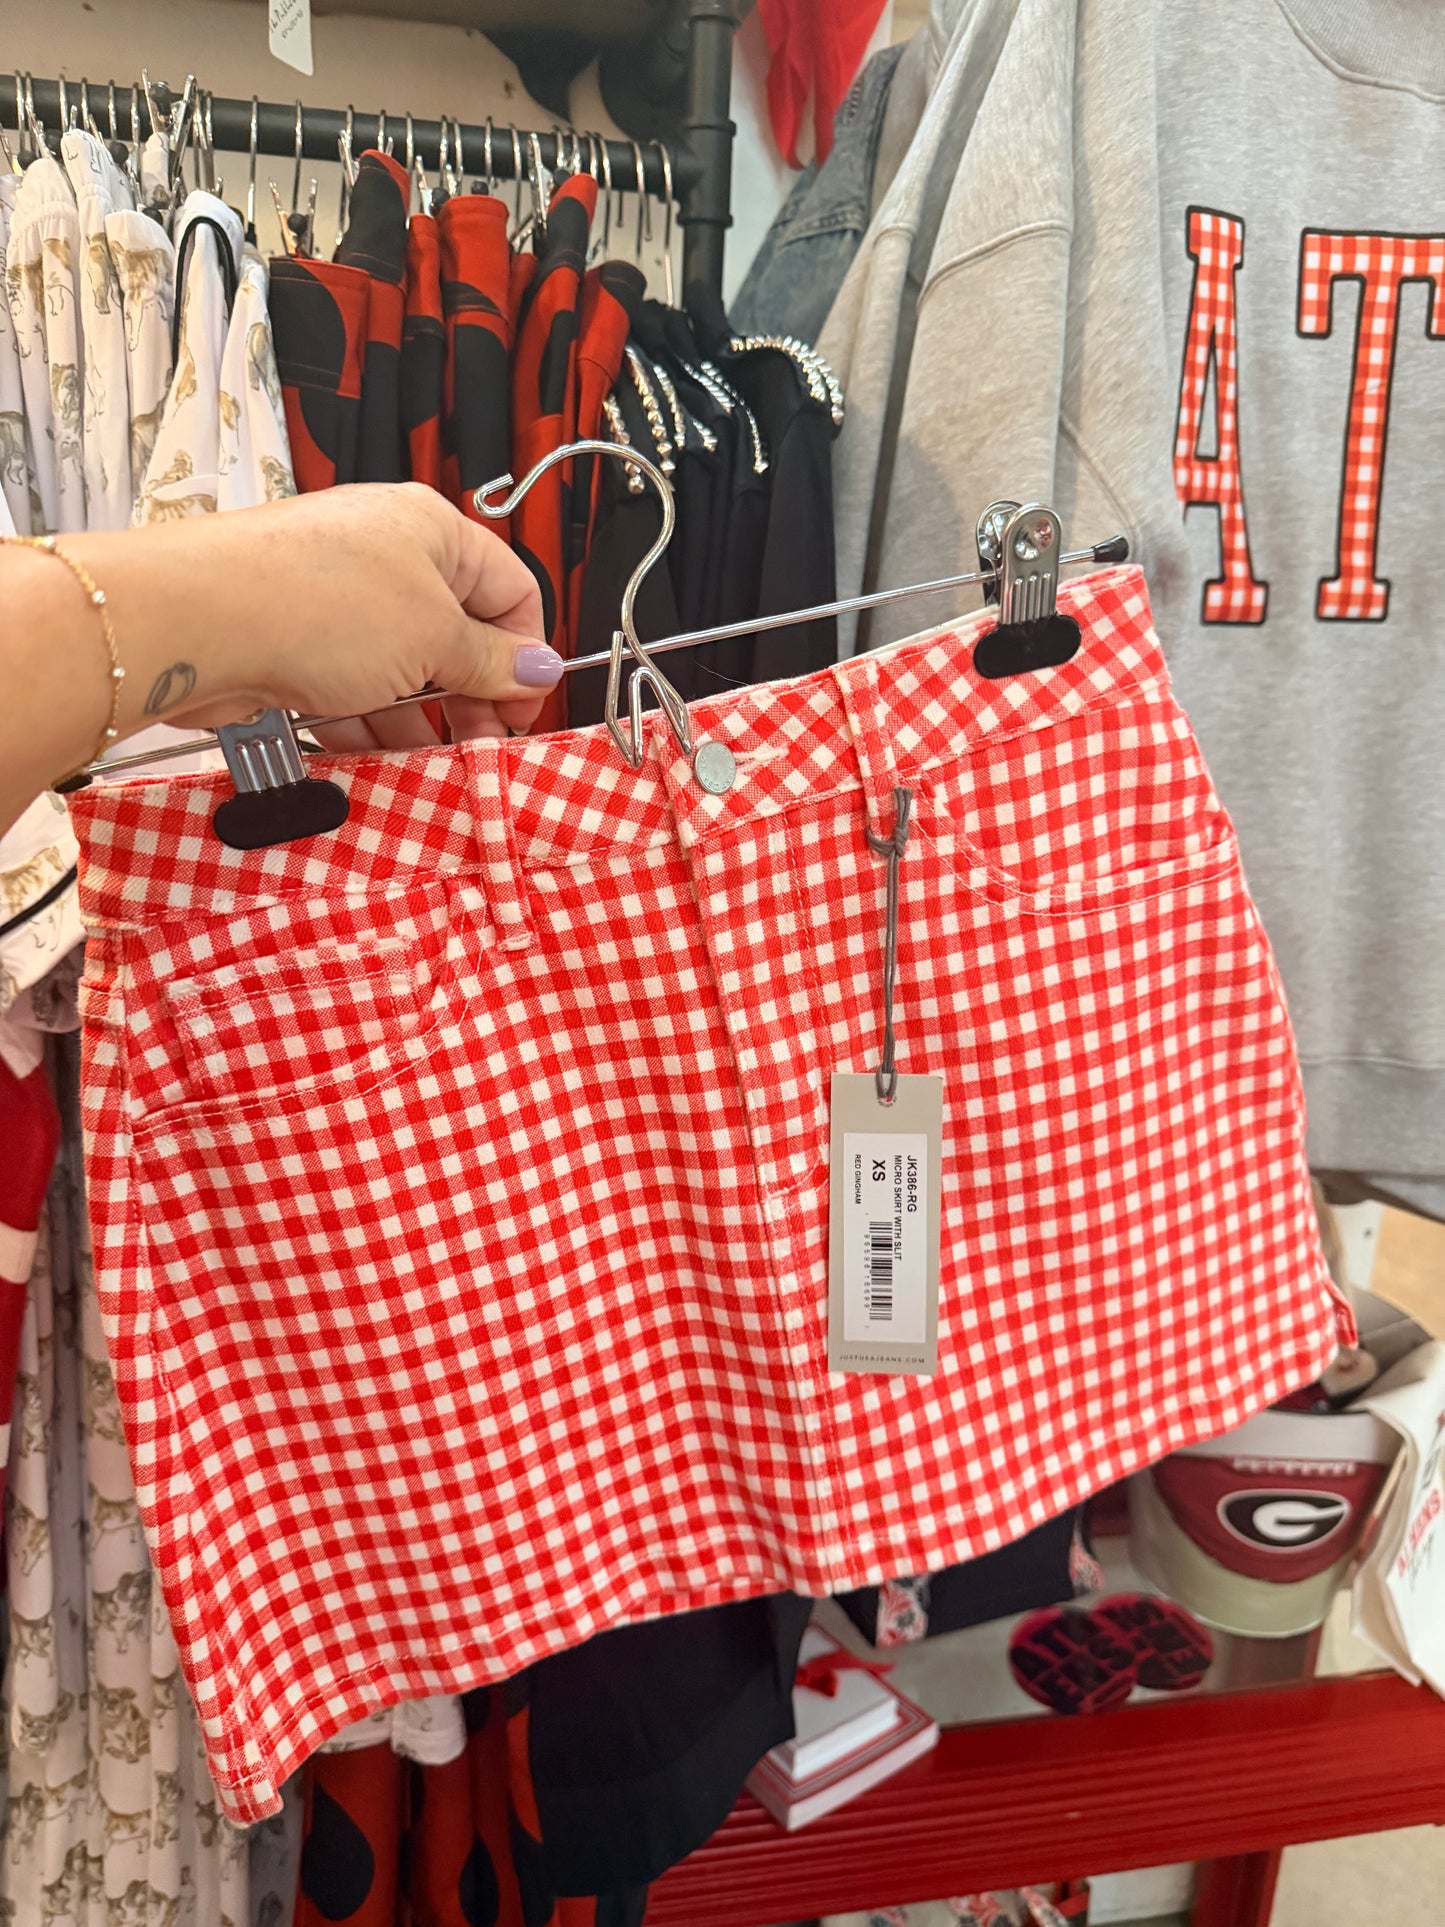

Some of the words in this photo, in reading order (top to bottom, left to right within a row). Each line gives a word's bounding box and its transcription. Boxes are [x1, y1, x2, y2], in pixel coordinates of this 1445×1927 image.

[854, 1154, 862, 1170] RED
[872, 1159, 888, 1182] XS
[893, 1154, 903, 1186] MICRO
[854, 1171, 862, 1205] GINGHAM
[906, 1154, 918, 1213] JK386-RG
[893, 1186, 903, 1215] SKIRT
[893, 1216, 903, 1240] WITH
[893, 1241, 903, 1262] SLIT
